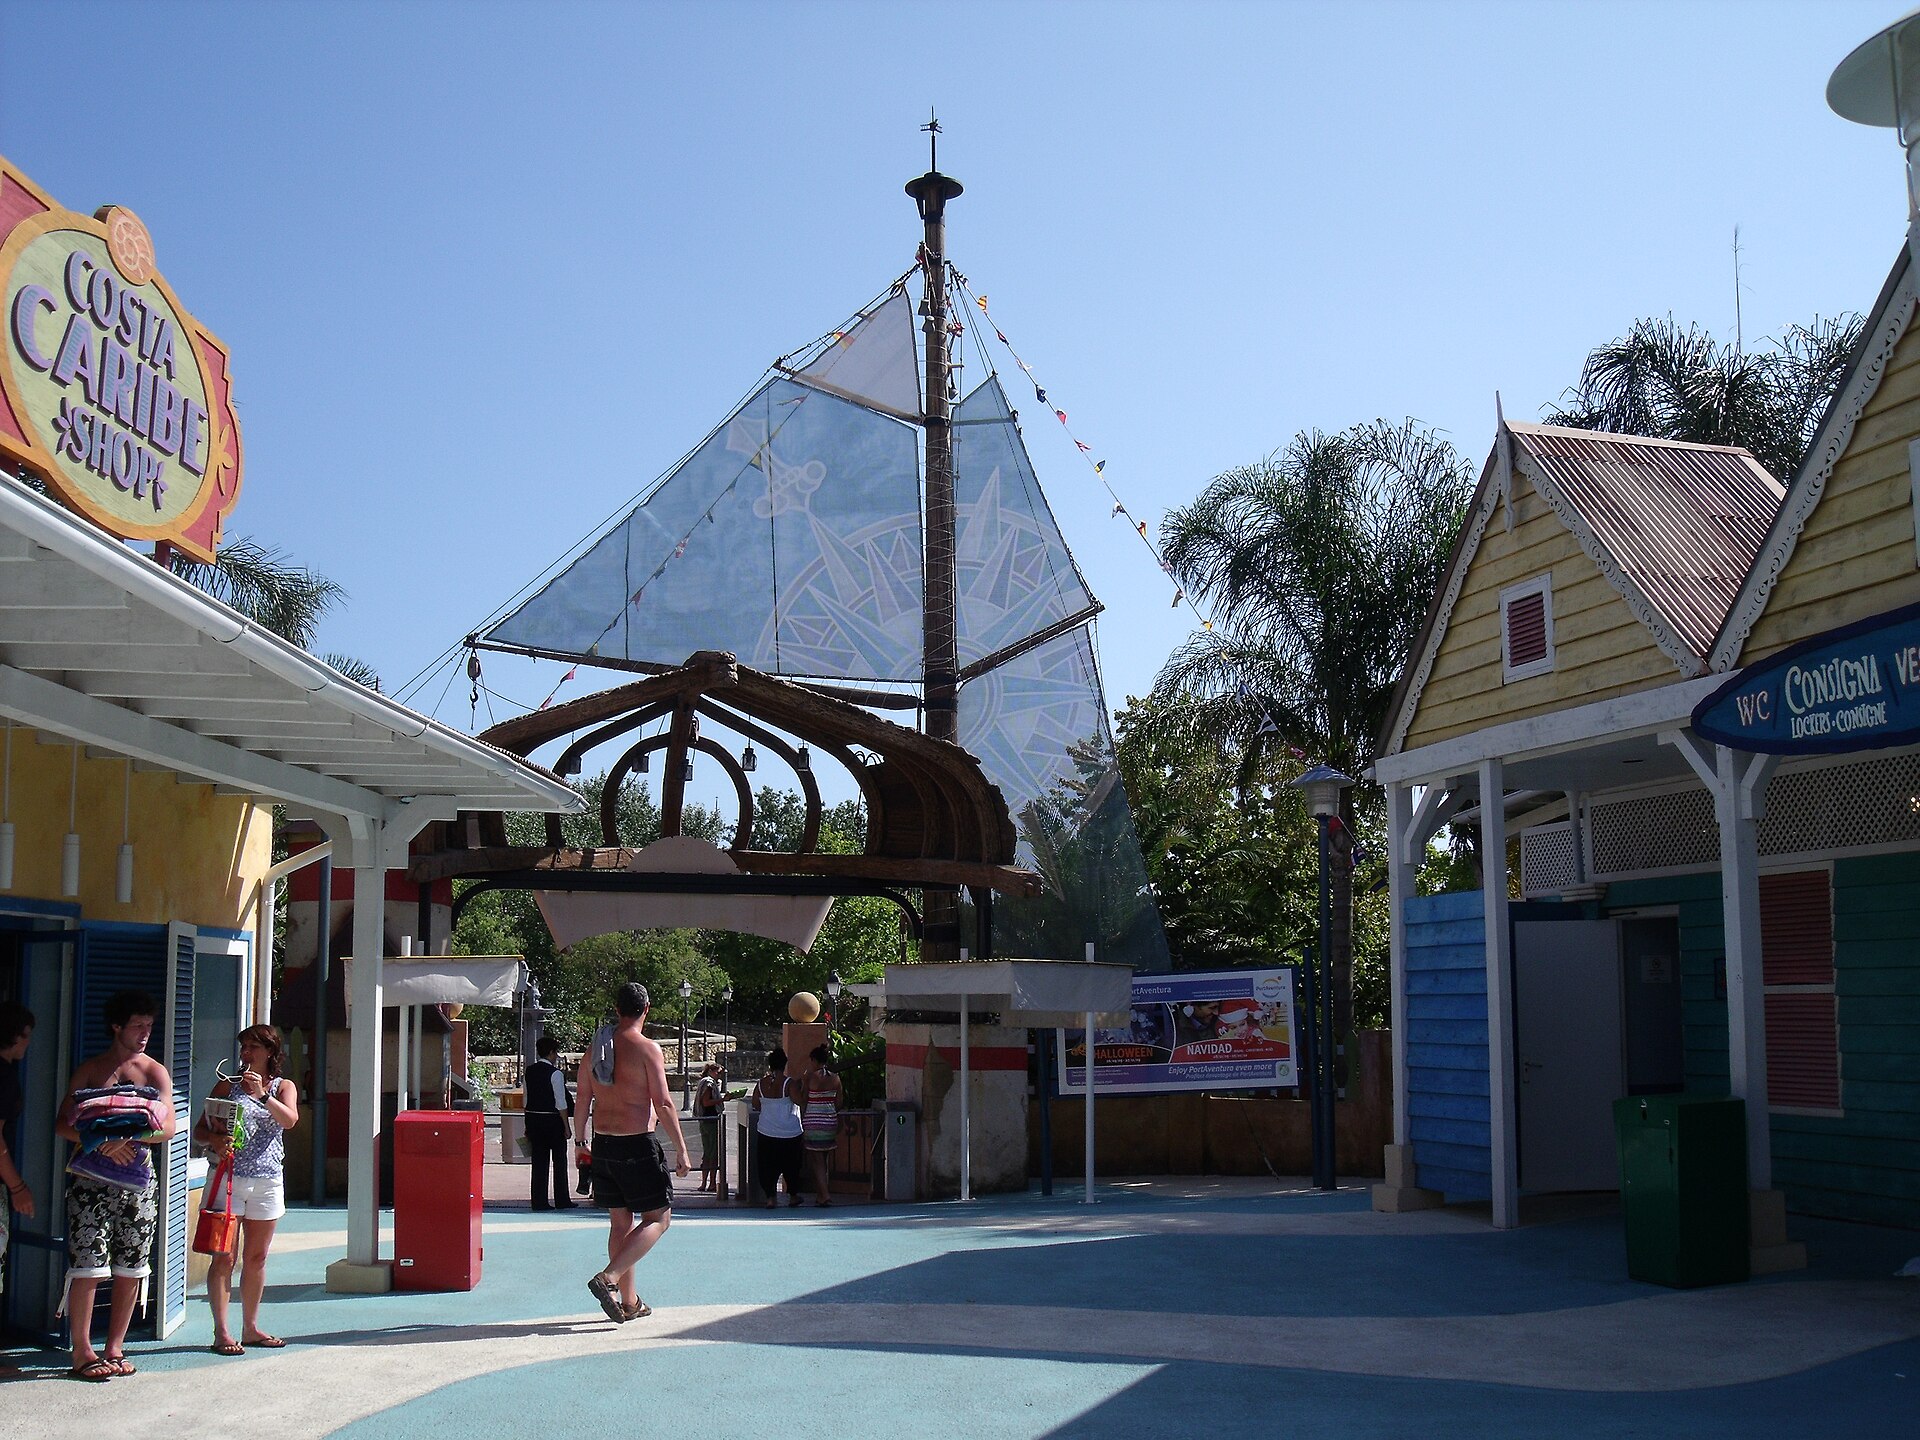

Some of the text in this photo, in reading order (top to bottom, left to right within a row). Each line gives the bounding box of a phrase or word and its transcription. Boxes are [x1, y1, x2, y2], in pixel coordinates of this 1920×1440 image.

[64, 250, 177, 381] COSTA
[11, 284, 209, 477] CARIBE
[67, 405, 157, 501] SHOP
[1785, 654, 1882, 715] CONSIGNA
[1895, 647, 1920, 685] VE
[1736, 690, 1770, 727] WC
[1790, 701, 1887, 739] LOCKERS CONSIGNE
[1131, 986, 1172, 995] rtAventura
[1093, 1047, 1153, 1059] HALLOWEEN
[1187, 1043, 1232, 1055] NAVIDAD
[1168, 1065, 1188, 1075] Enjoy
[1189, 1064, 1233, 1073] PortAventura
